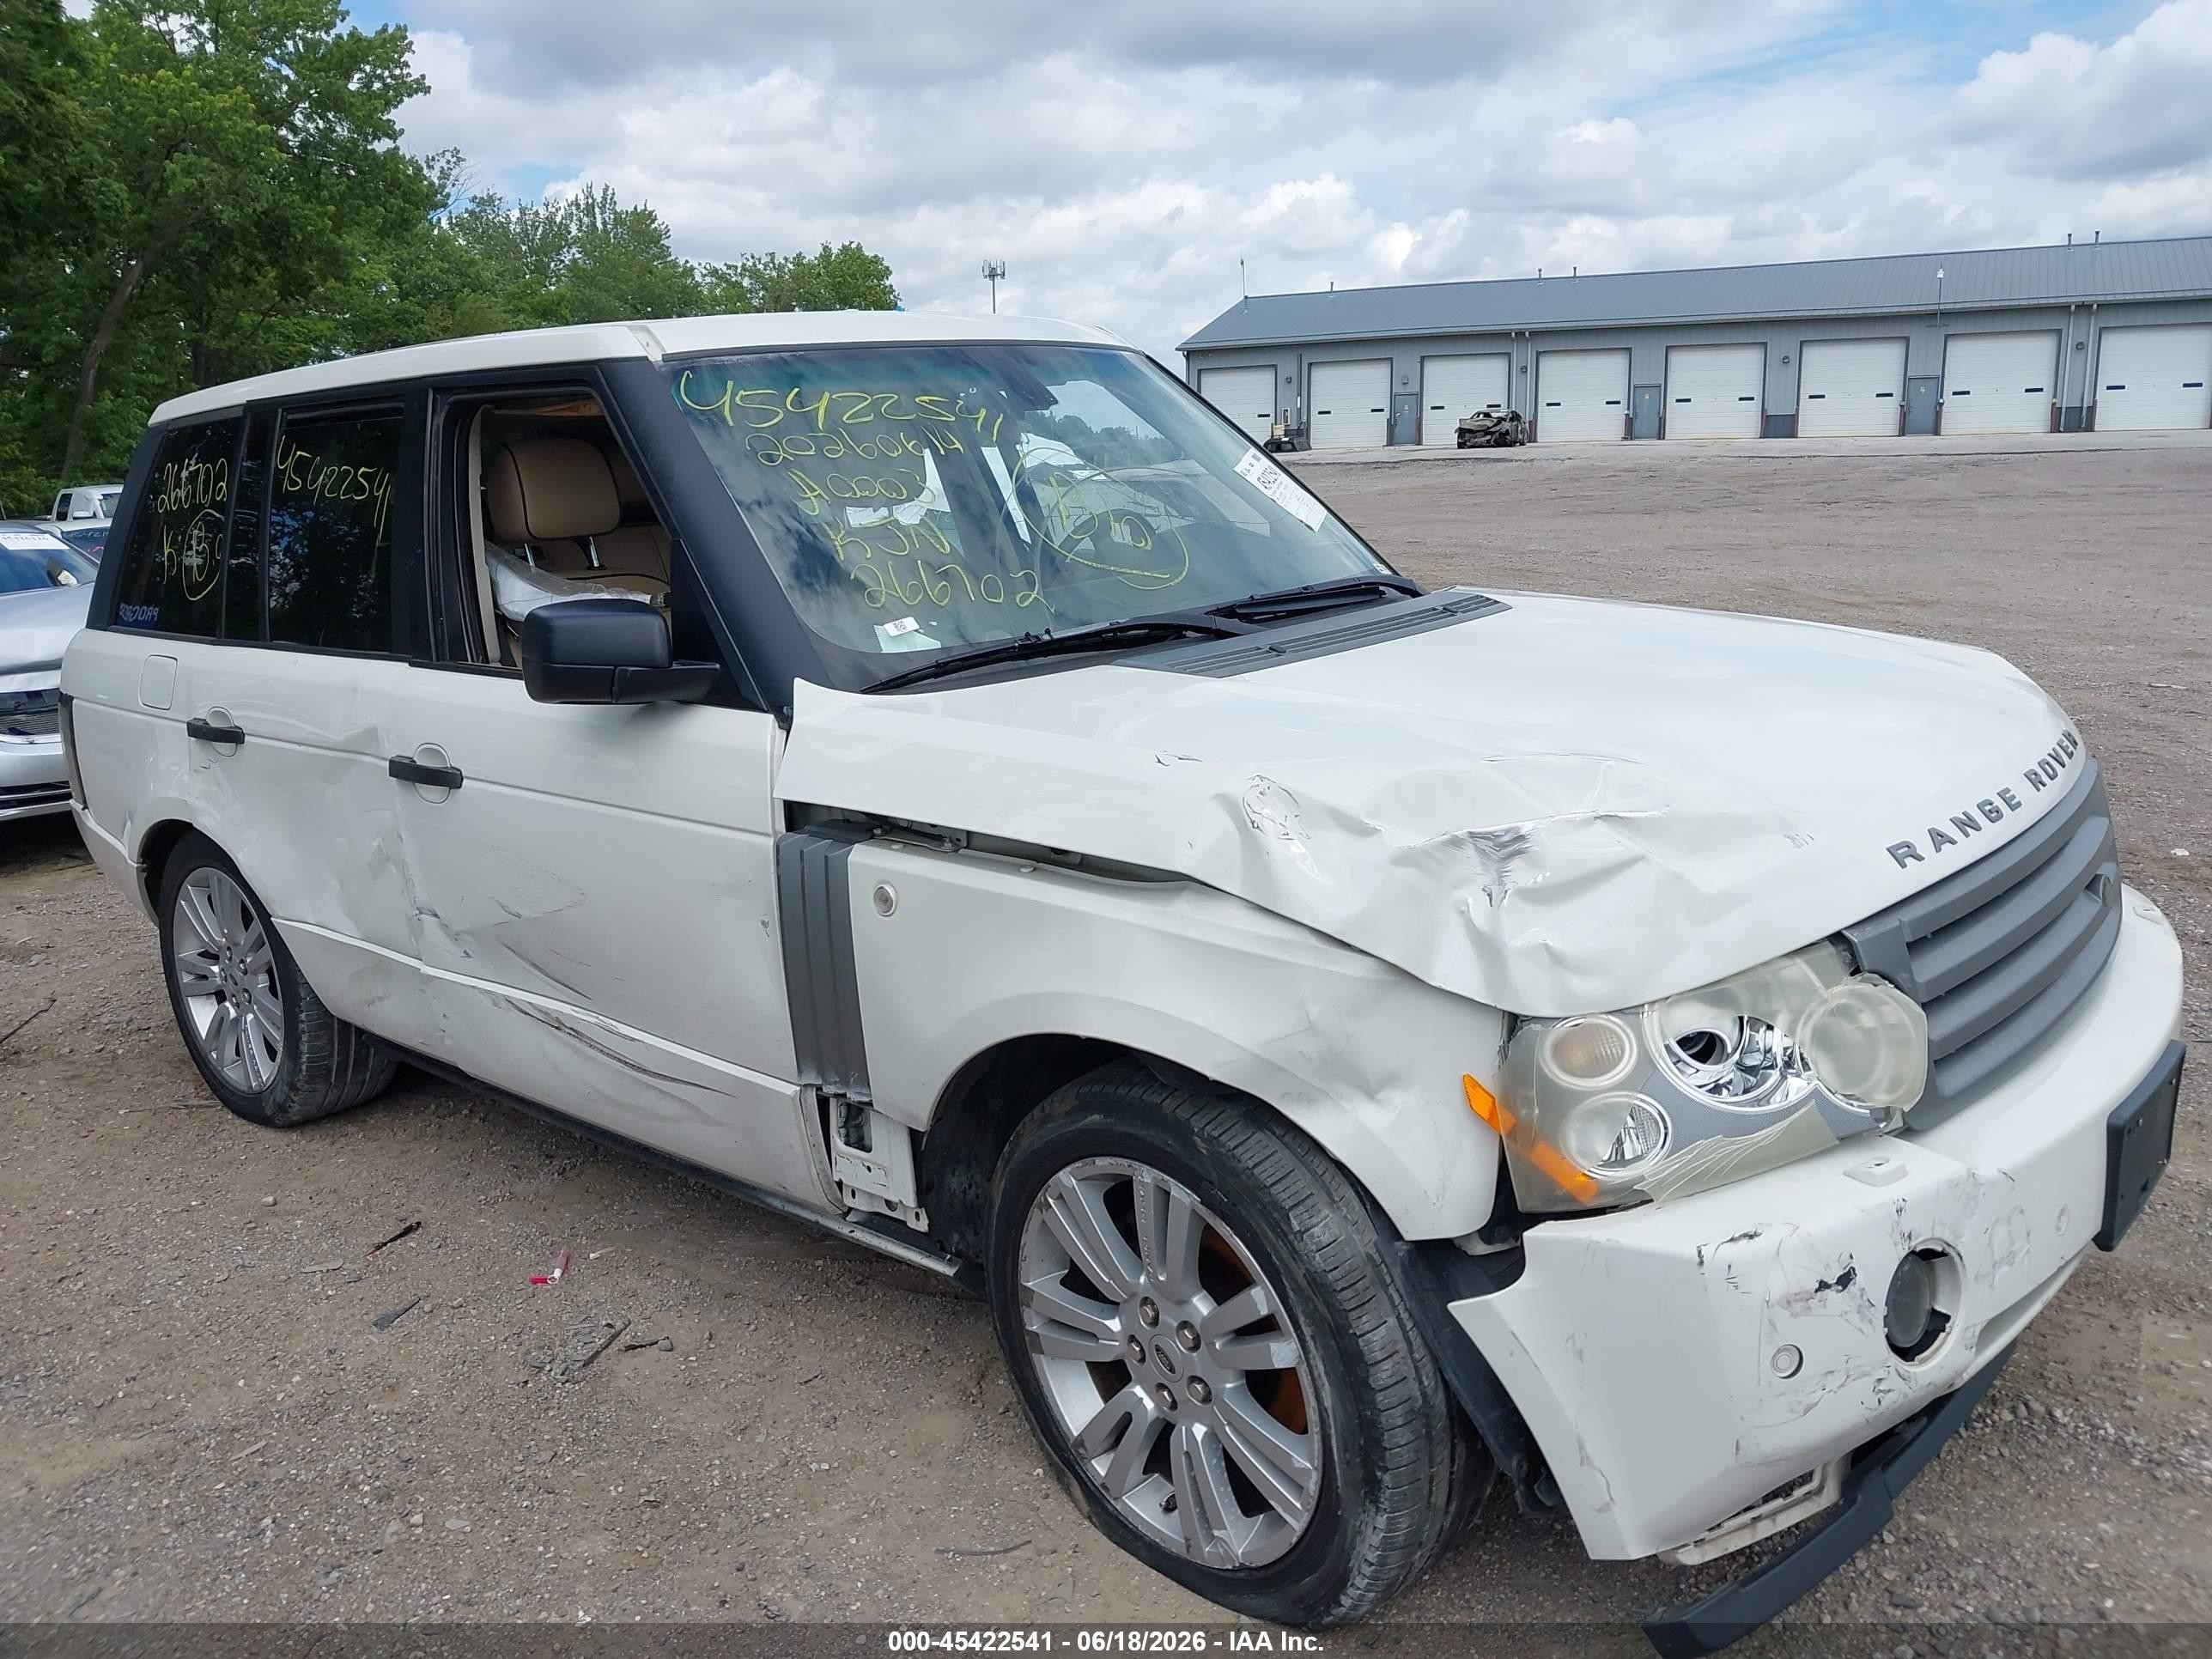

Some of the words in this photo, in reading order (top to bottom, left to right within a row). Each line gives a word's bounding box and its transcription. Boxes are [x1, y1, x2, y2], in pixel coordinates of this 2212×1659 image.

[679, 371, 1004, 443] 45422541
[158, 453, 228, 514] 266702
[277, 435, 391, 544] 45422541
[851, 560, 1055, 614] 266702
[1886, 787, 2022, 869] RANGE
[2023, 729, 2079, 792] ROVER
